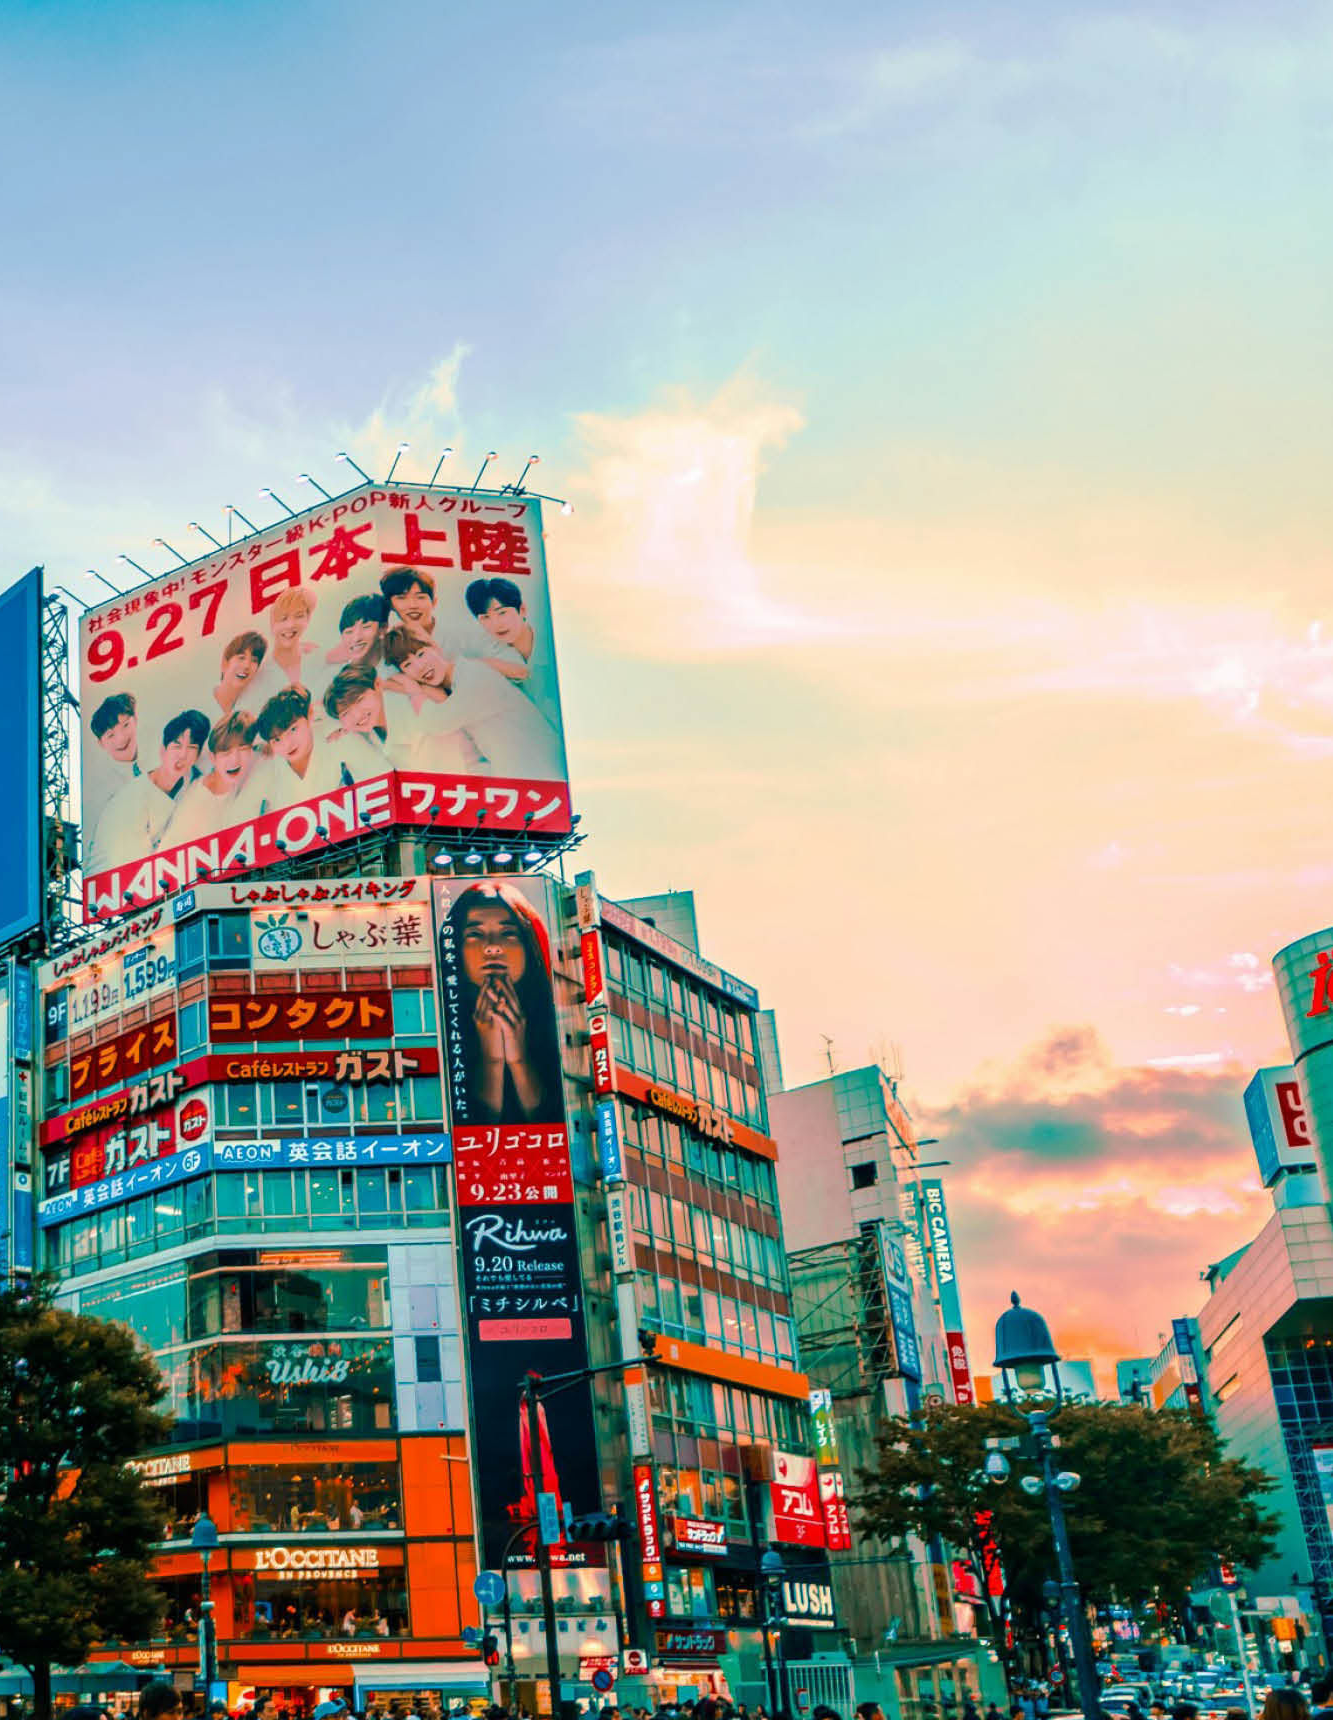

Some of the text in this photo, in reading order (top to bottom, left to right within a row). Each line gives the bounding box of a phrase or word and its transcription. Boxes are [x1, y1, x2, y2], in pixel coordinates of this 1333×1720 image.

[87, 512, 532, 684] 9.27 日本上陸
[400, 782, 562, 822] ワナワン
[230, 879, 417, 904] しゃぶしゃぶバイキング
[313, 913, 424, 950] しゃぶ葉
[48, 1002, 67, 1026] 9F
[211, 996, 385, 1031] コンタクト
[72, 1019, 175, 1090] プライス
[336, 1050, 419, 1081] ガスト
[594, 1047, 610, 1088] ガスト
[130, 1071, 185, 1114] ガスト
[183, 1116, 207, 1133] ガスト
[104, 1120, 171, 1176] ガスト
[223, 1139, 445, 1163] AEON 英会話イーオン
[456, 1127, 565, 1157] ユリゴコロ
[47, 1159, 70, 1188] 7F
[83, 1160, 178, 1209] 英会話イーオン
[184, 1152, 200, 1171] 6F
[465, 1214, 568, 1252] Rihwa
[925, 1187, 955, 1285] BIC CAMERA
[474, 1255, 565, 1272] 9.20 Release
[780, 1489, 814, 1517] アコム
[826, 1504, 840, 1535] アコム
[255, 1547, 380, 1570] L'OCCITANE
[507, 1551, 587, 1564] www.wa.net
[278, 1570, 359, 1580] EN PROVENCE
[783, 1580, 835, 1616] LUSH
